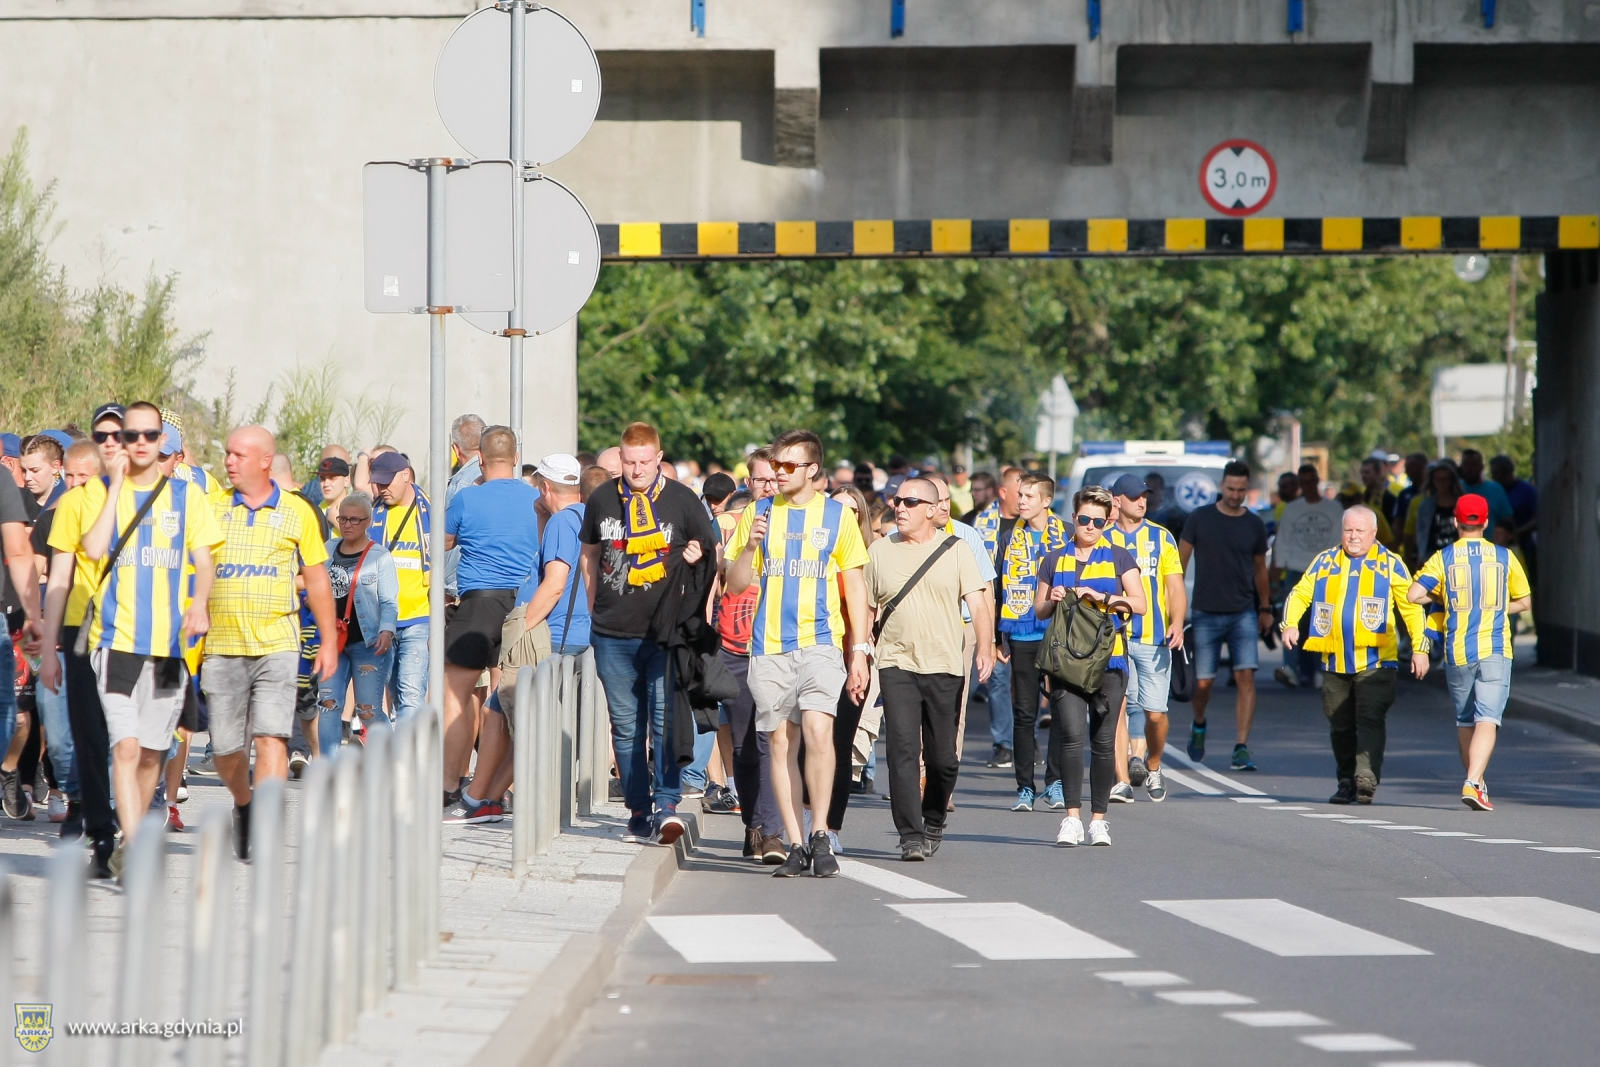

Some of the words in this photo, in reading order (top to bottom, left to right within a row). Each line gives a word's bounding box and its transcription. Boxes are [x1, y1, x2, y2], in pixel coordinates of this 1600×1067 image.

[1214, 167, 1248, 190] 3,0
[1251, 176, 1267, 187] m
[141, 546, 180, 570] GDYNIA
[789, 559, 827, 579] GDYNIA
[216, 563, 278, 579] GDYNIA
[1448, 562, 1504, 612] 90
